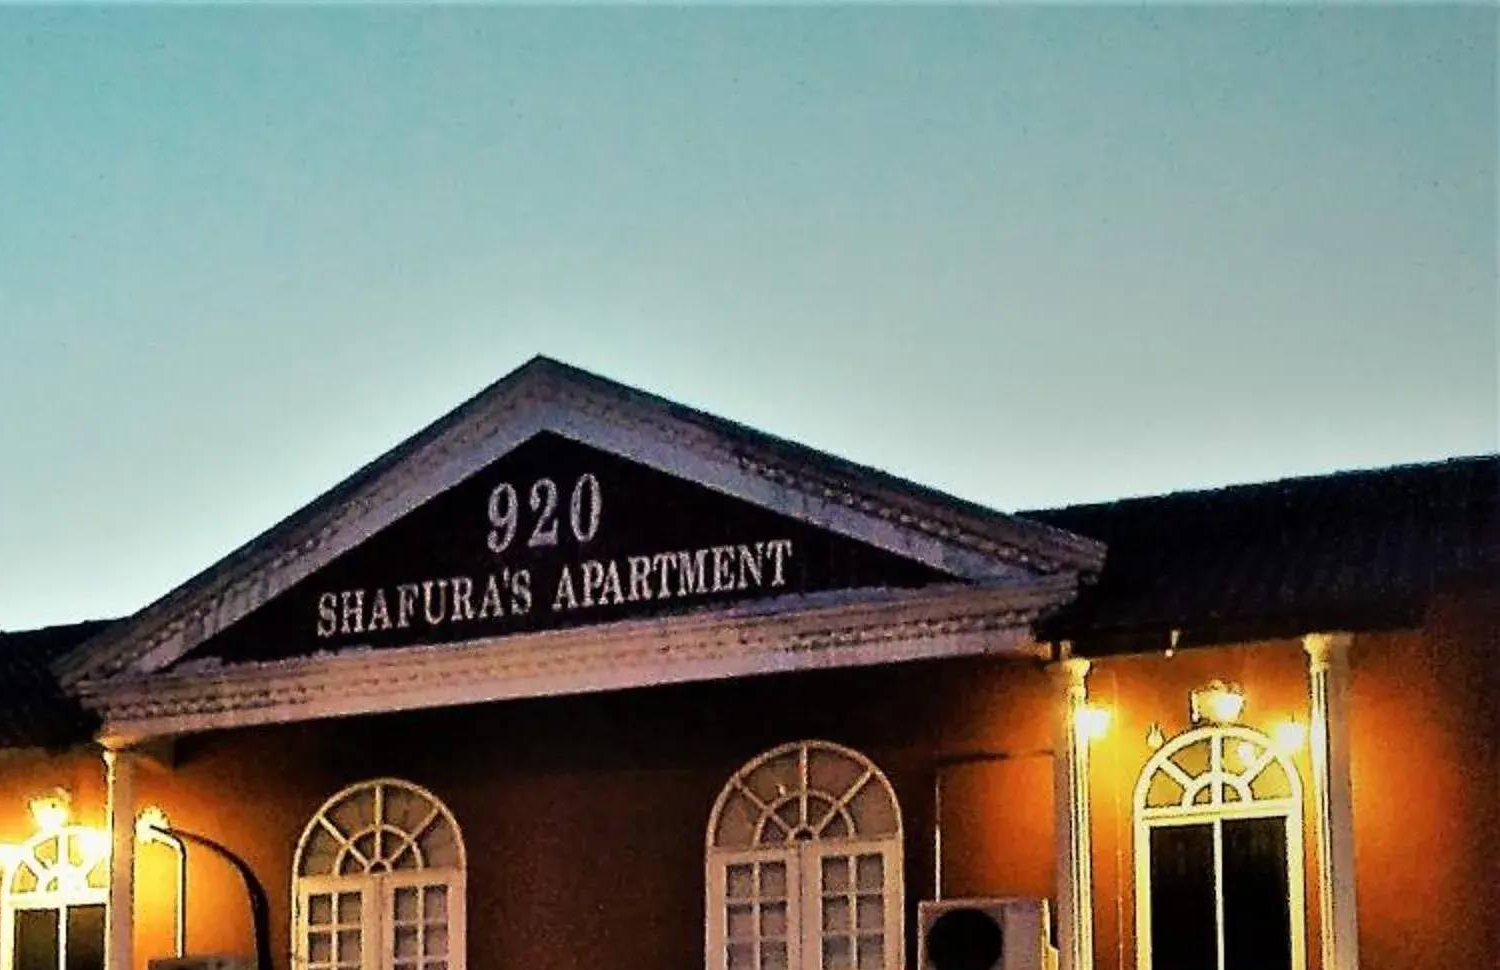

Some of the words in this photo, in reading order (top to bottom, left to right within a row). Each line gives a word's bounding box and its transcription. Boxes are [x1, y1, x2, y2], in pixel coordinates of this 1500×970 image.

[487, 472, 602, 553] 920
[316, 567, 533, 638] SHAFURA'S
[551, 538, 793, 611] APARTMENT
